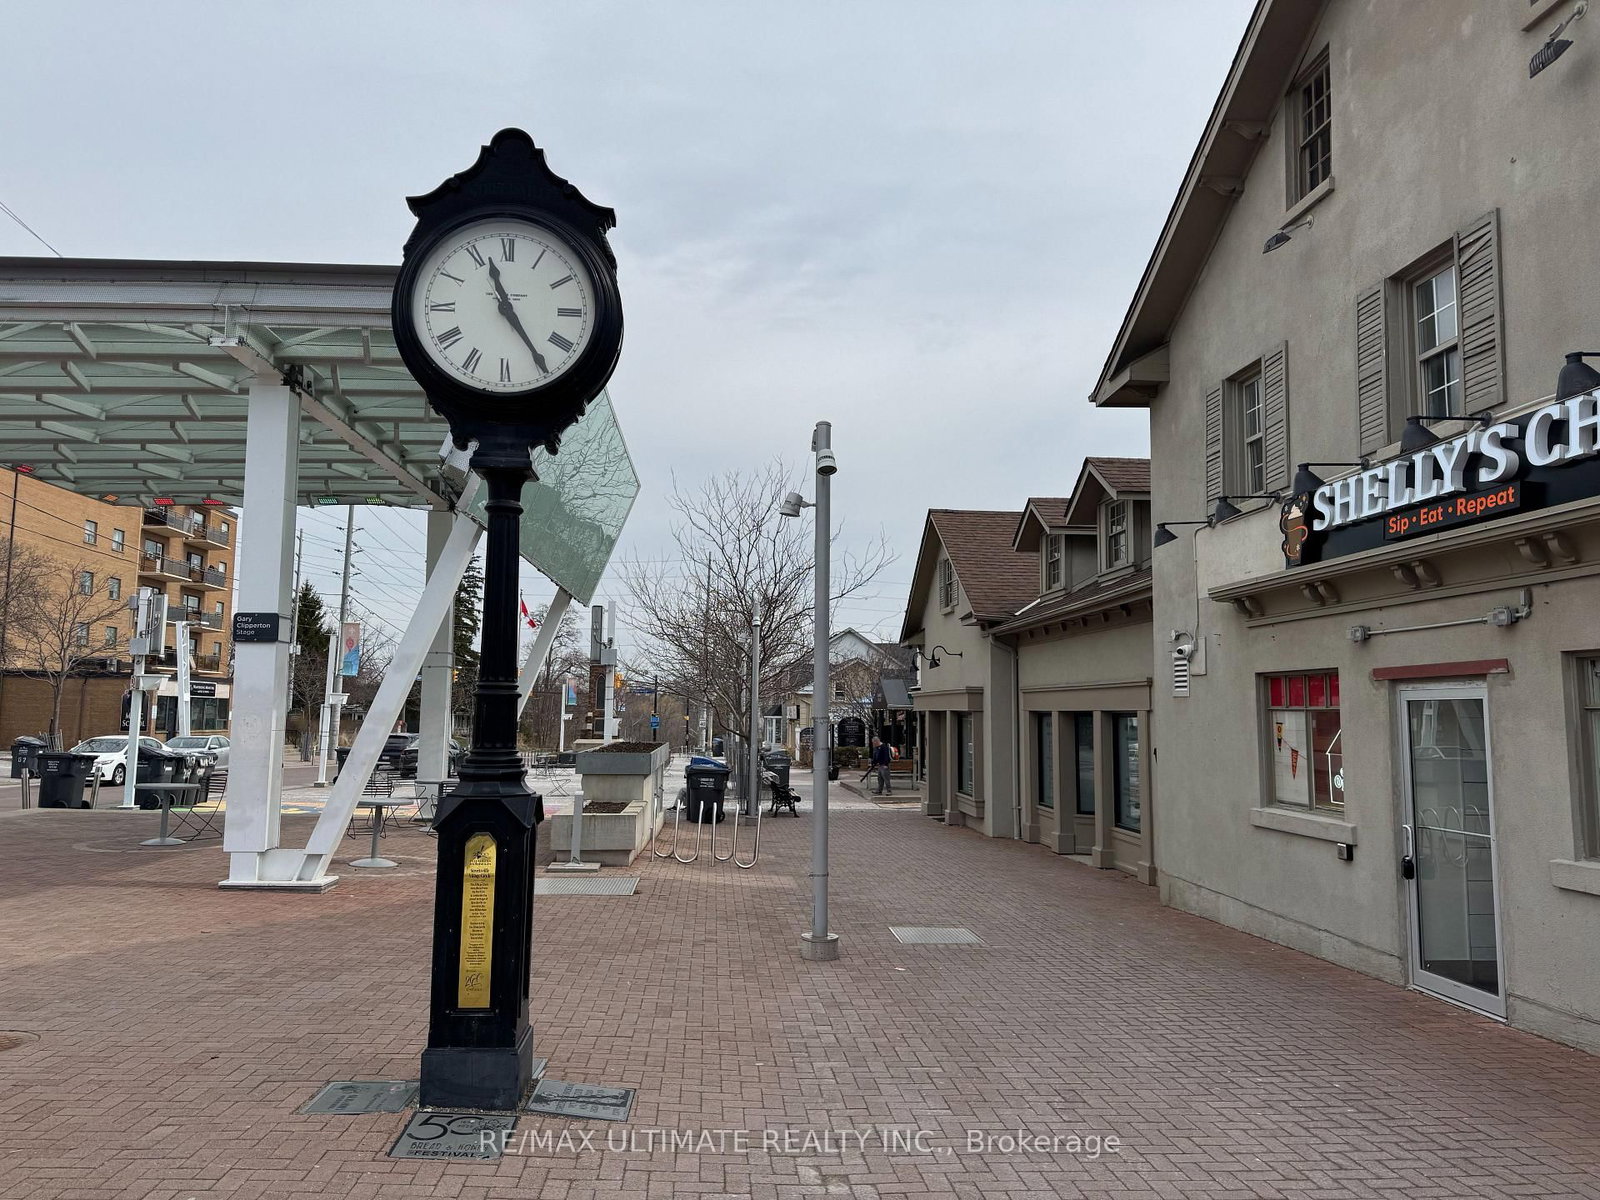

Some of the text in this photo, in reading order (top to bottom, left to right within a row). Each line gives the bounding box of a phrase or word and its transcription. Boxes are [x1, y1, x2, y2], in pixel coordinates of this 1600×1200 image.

[1313, 423, 1520, 532] SHELLY'S
[1388, 486, 1515, 534] Sip Eat Repeat
[410, 1142, 442, 1150] BREAD
